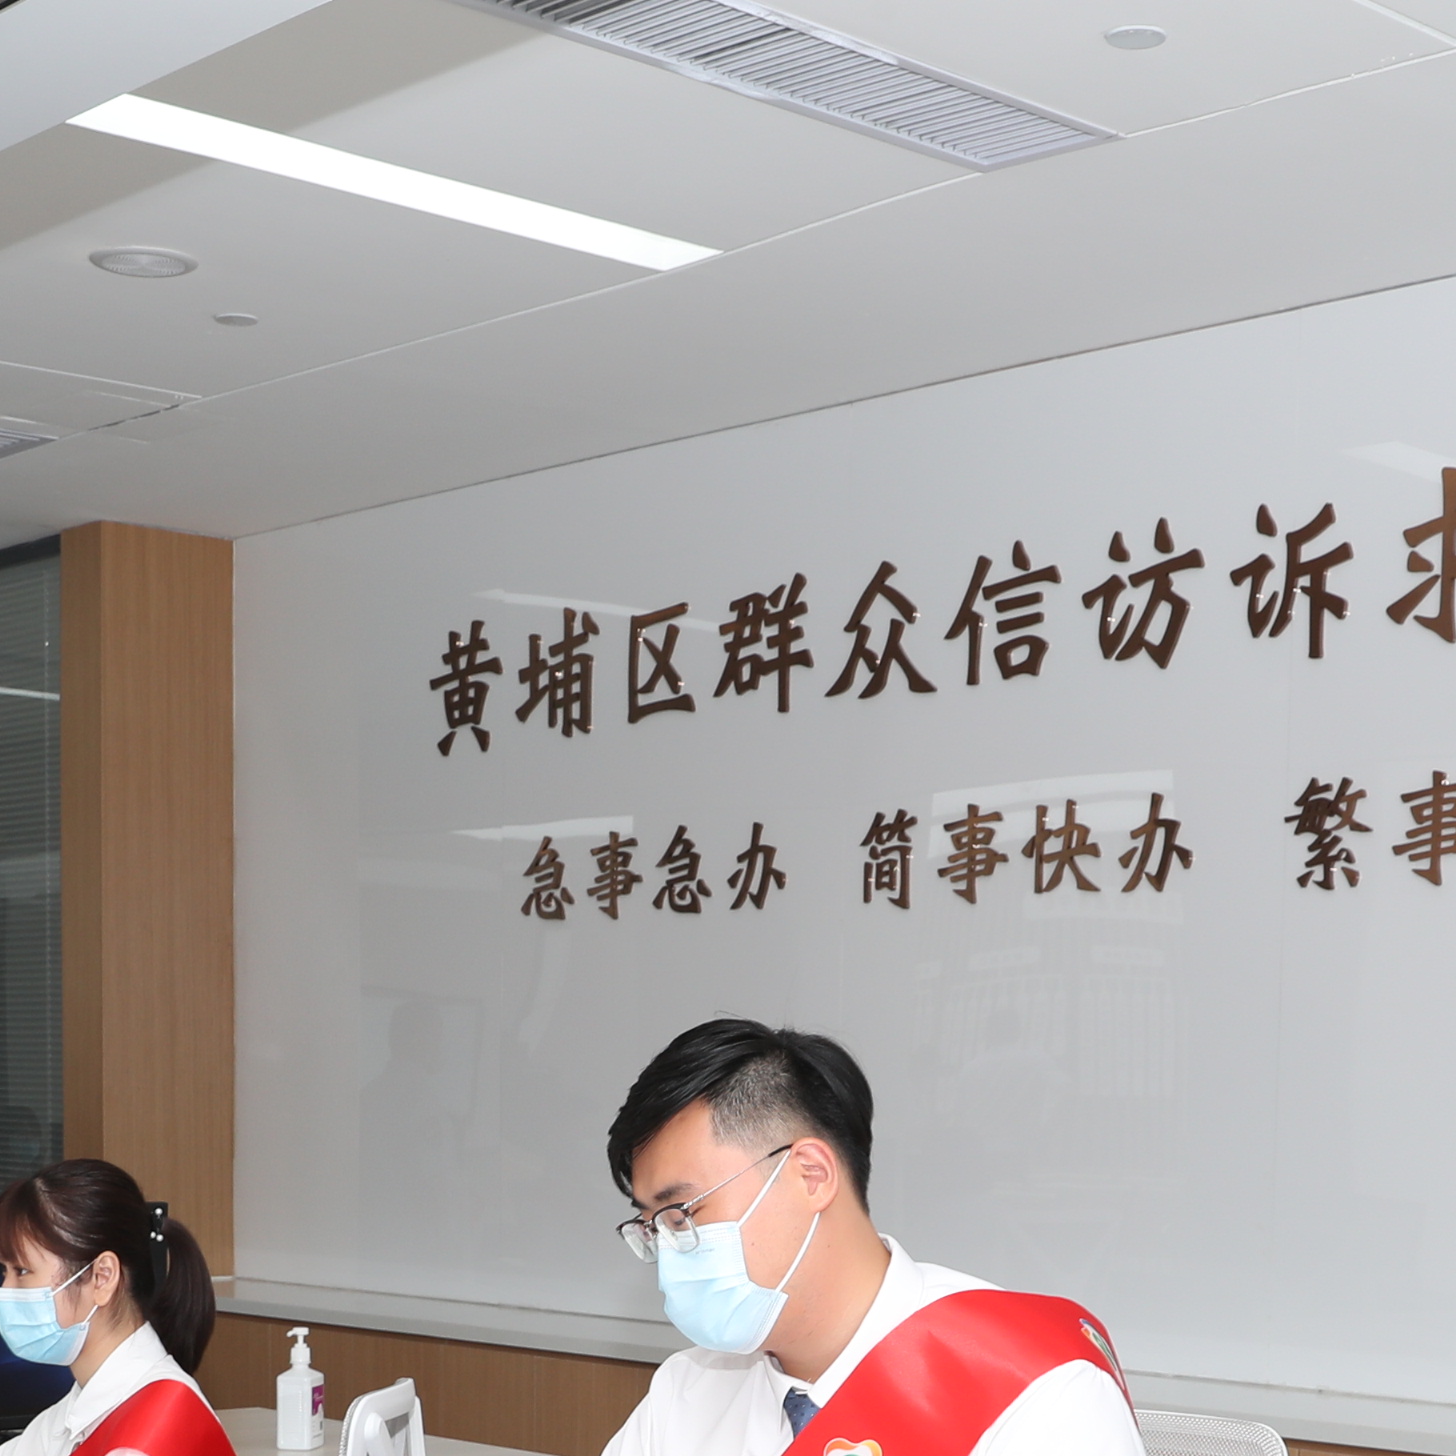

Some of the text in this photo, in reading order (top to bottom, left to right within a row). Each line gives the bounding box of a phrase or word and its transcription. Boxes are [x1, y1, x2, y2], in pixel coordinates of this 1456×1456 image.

[520, 821, 787, 921] 急事急办
[859, 792, 1193, 909] 简事快办
